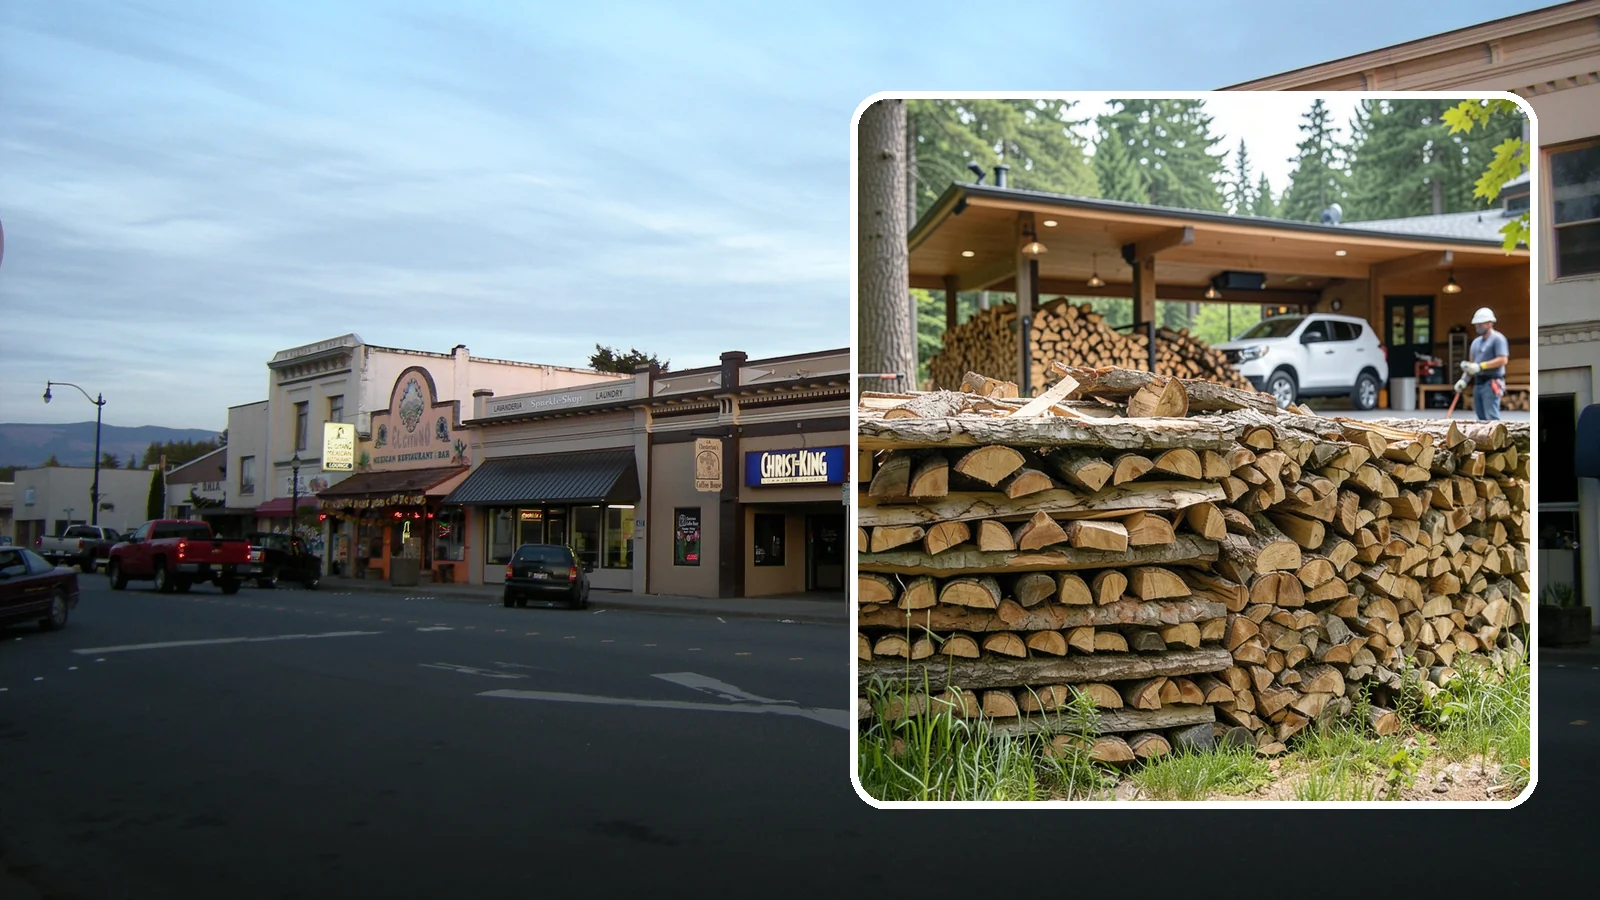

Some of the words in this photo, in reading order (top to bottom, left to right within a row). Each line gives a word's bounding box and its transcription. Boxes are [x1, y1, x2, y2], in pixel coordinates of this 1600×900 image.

[562, 394, 582, 404] Shop
[596, 389, 623, 400] LAUNDRY
[494, 402, 523, 412] LAVANDERIA
[374, 455, 396, 464] MEXICAN
[398, 451, 433, 462] RESTAURANT
[438, 450, 450, 459] BAR
